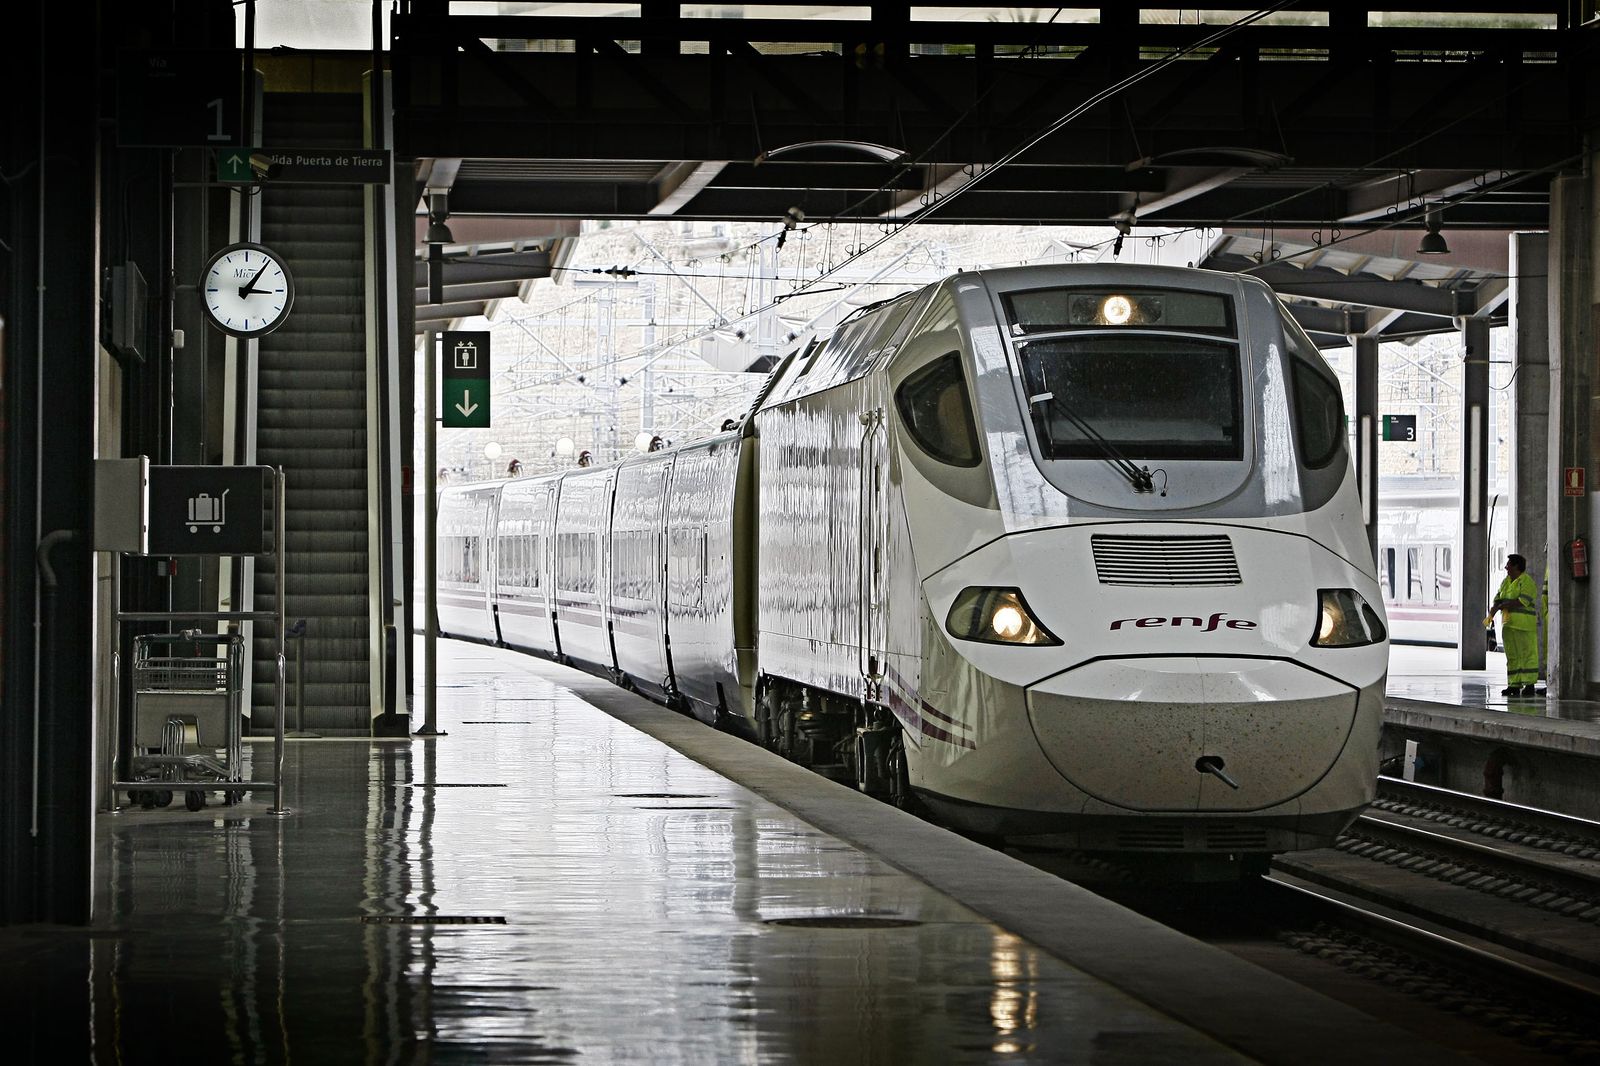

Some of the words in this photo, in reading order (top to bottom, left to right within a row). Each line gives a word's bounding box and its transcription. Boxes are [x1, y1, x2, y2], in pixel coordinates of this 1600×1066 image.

[207, 98, 232, 141] 1
[296, 155, 332, 166] Puerta
[335, 155, 349, 166] de
[352, 156, 383, 167] Tierra
[1406, 427, 1414, 440] 3
[1110, 612, 1258, 632] renfe
